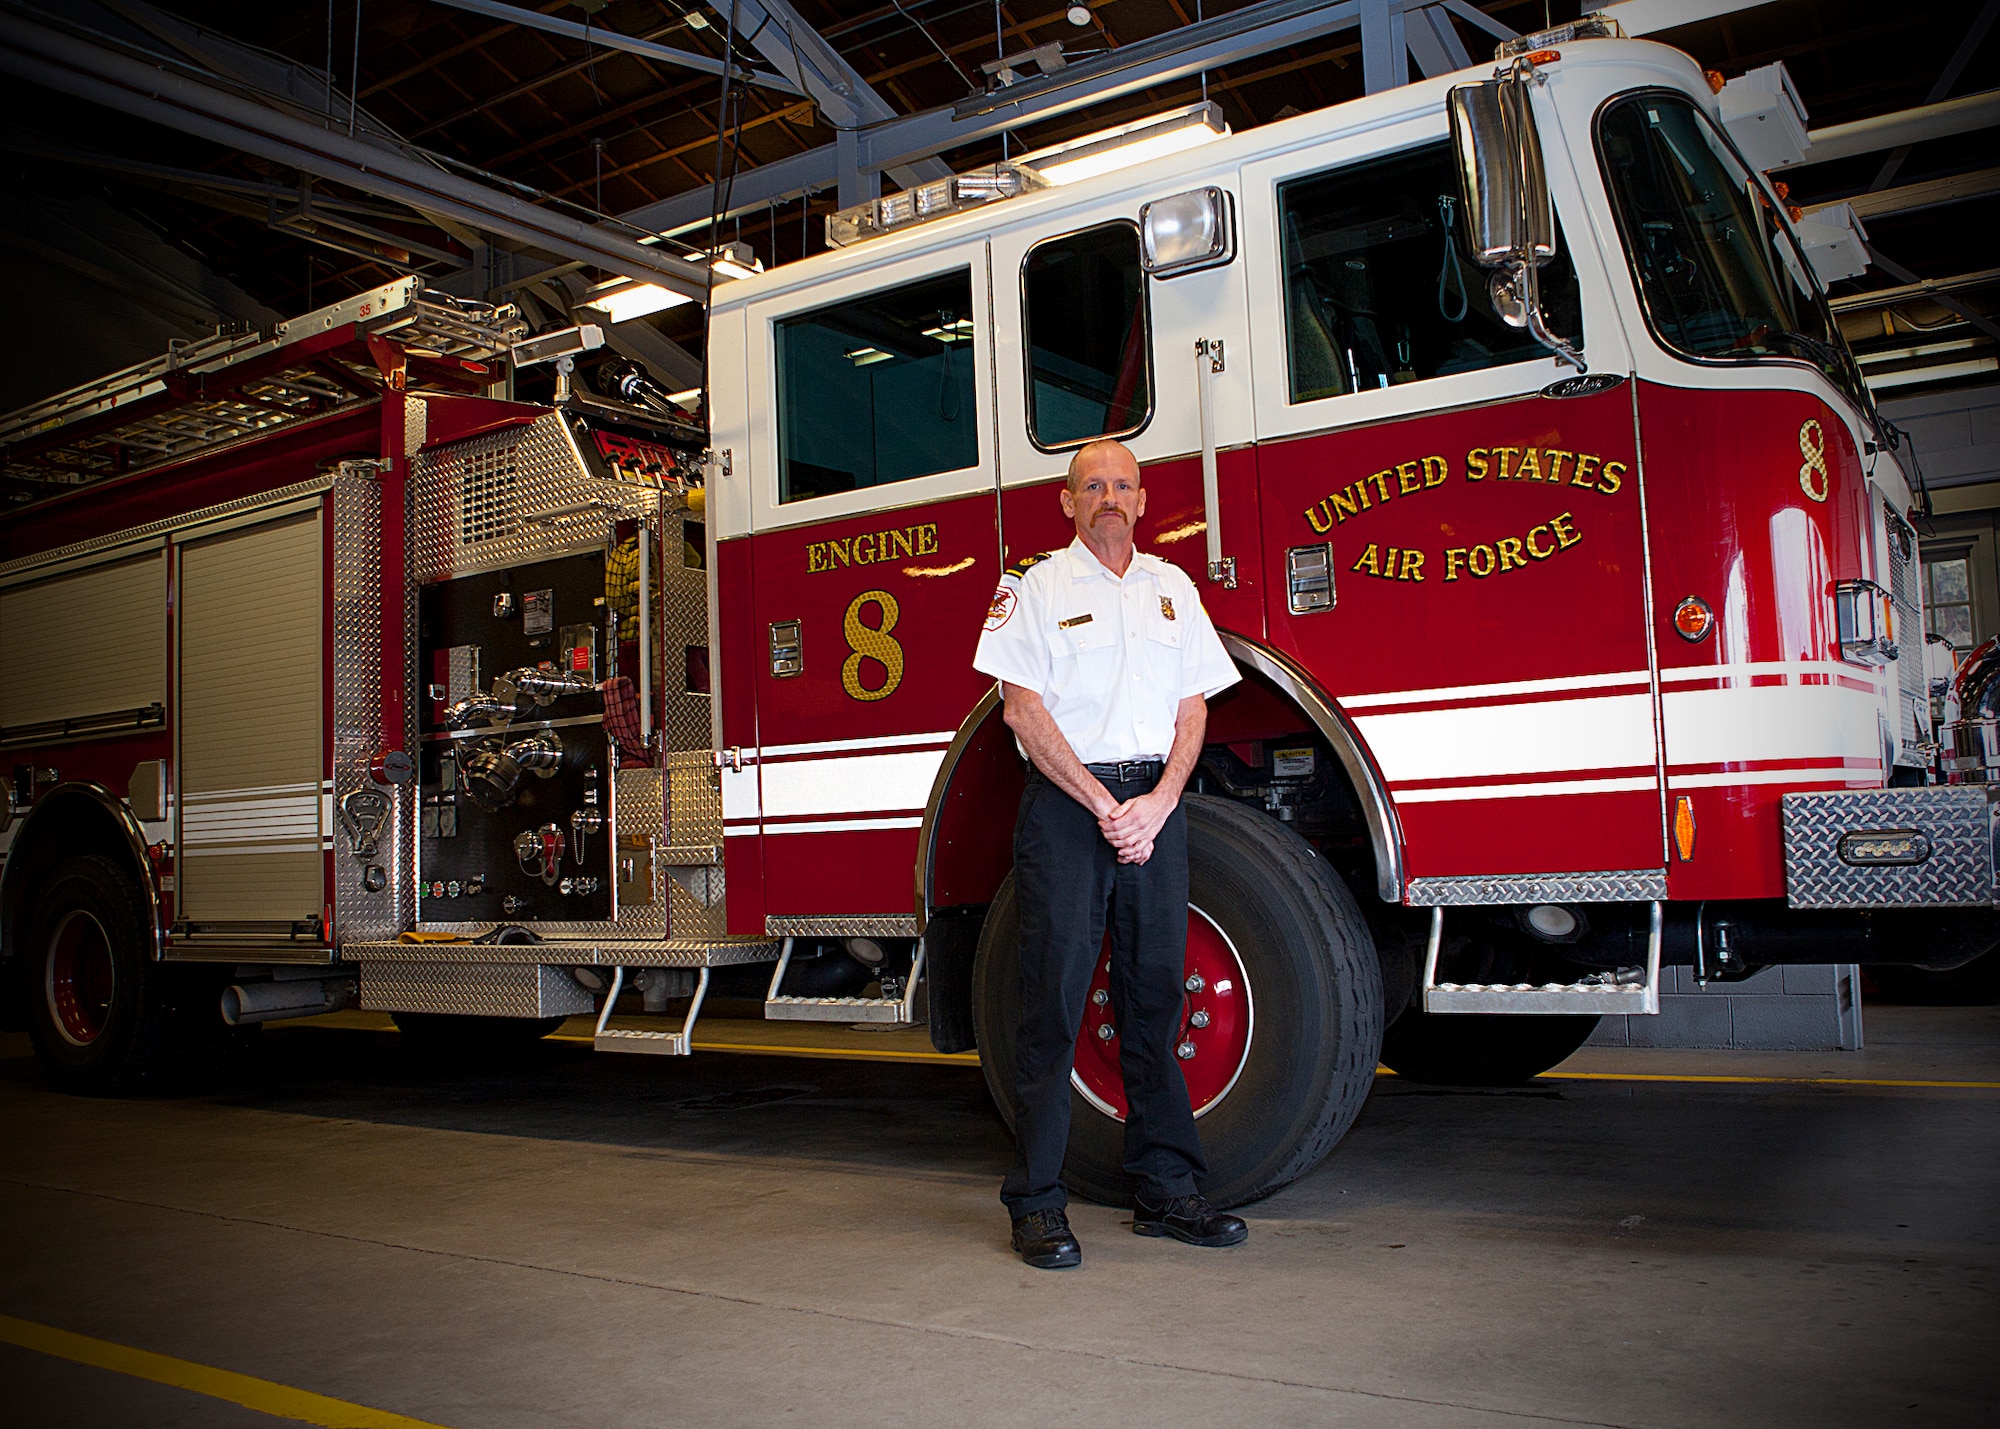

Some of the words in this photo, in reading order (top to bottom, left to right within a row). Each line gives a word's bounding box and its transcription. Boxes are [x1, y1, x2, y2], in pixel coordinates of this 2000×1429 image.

[360, 304, 371, 317] 35
[1304, 454, 1449, 535] UNITED
[1465, 447, 1628, 495] STATES
[1799, 418, 1828, 503] 8
[806, 522, 939, 574] ENGINE
[1352, 543, 1425, 582] AIR
[1443, 512, 1583, 582] FORCE
[841, 589, 904, 702] 8
